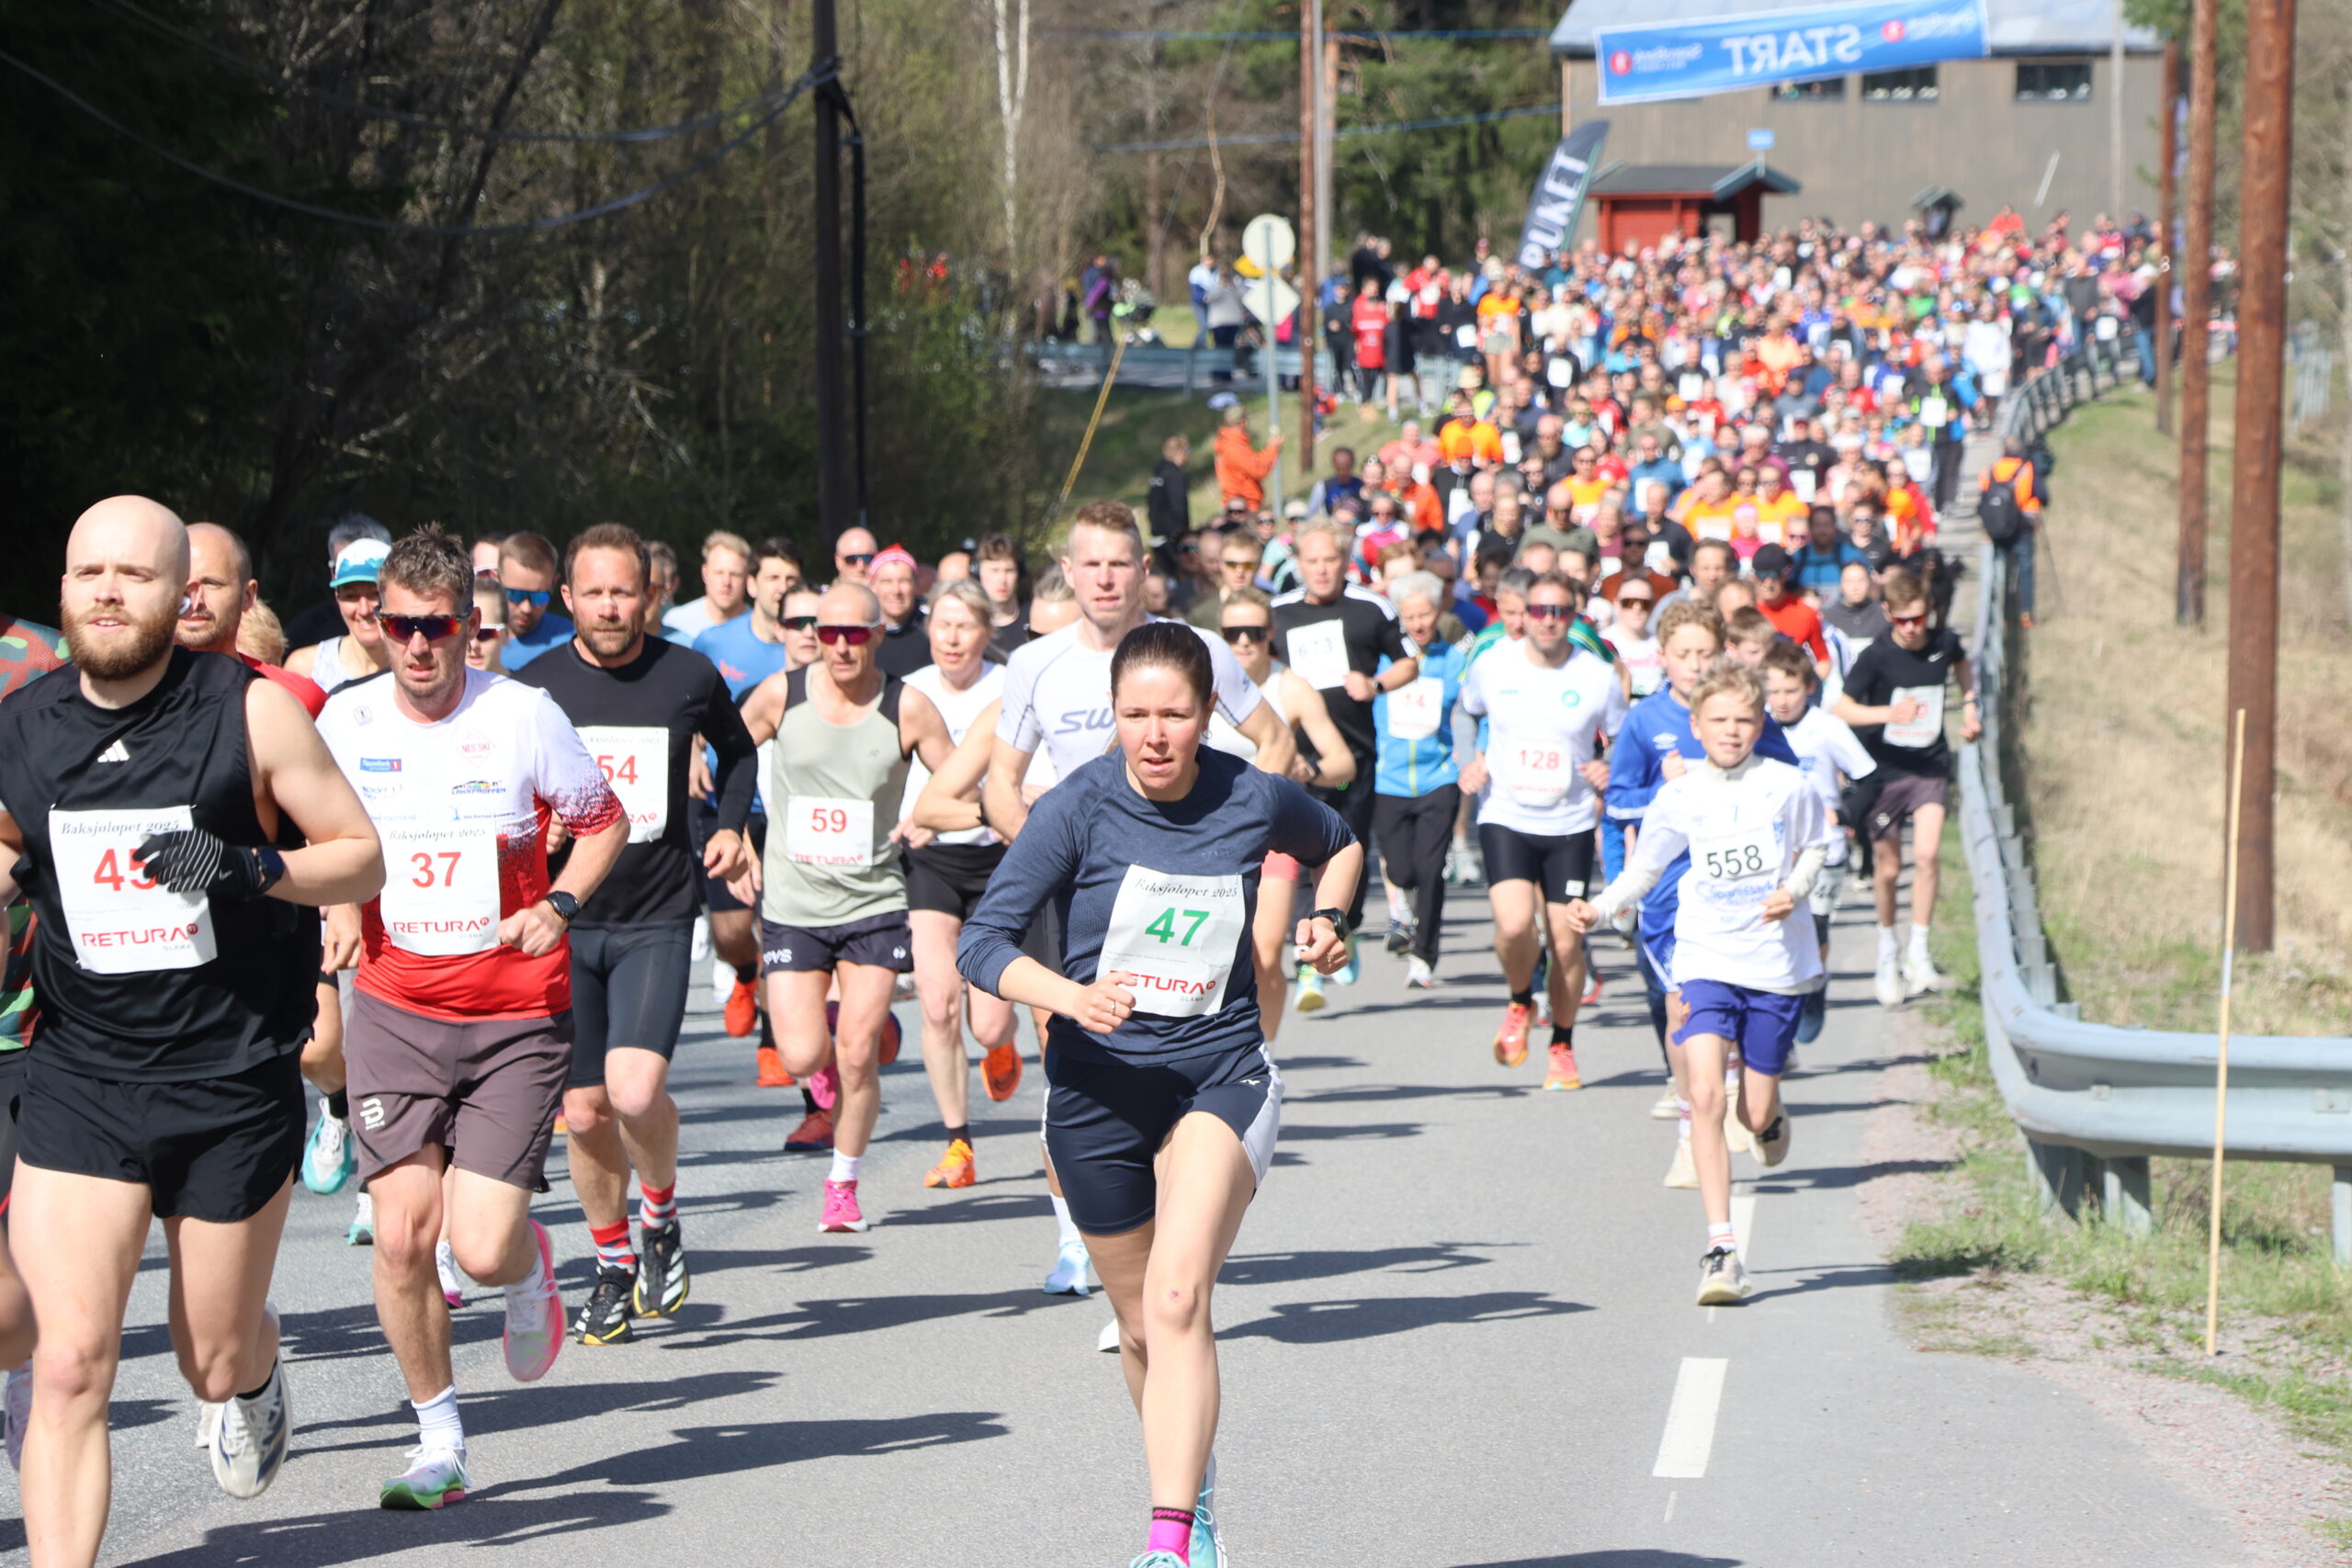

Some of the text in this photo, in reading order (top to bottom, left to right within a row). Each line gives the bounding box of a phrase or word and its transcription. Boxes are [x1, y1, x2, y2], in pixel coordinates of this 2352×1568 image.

[596, 754, 639, 785] 54
[1519, 749, 1560, 770] 128
[145, 820, 181, 832] 2025
[810, 808, 848, 833] 59
[458, 829, 486, 839] 2025
[93, 849, 159, 892] 45
[411, 852, 462, 888] 37
[1706, 844, 1762, 879] 558
[1212, 887, 1238, 898] 2025
[82, 927, 189, 947] RETURA
[393, 920, 481, 933] RETURA
[1144, 907, 1210, 947] 47
[1110, 970, 1205, 995] TURA
